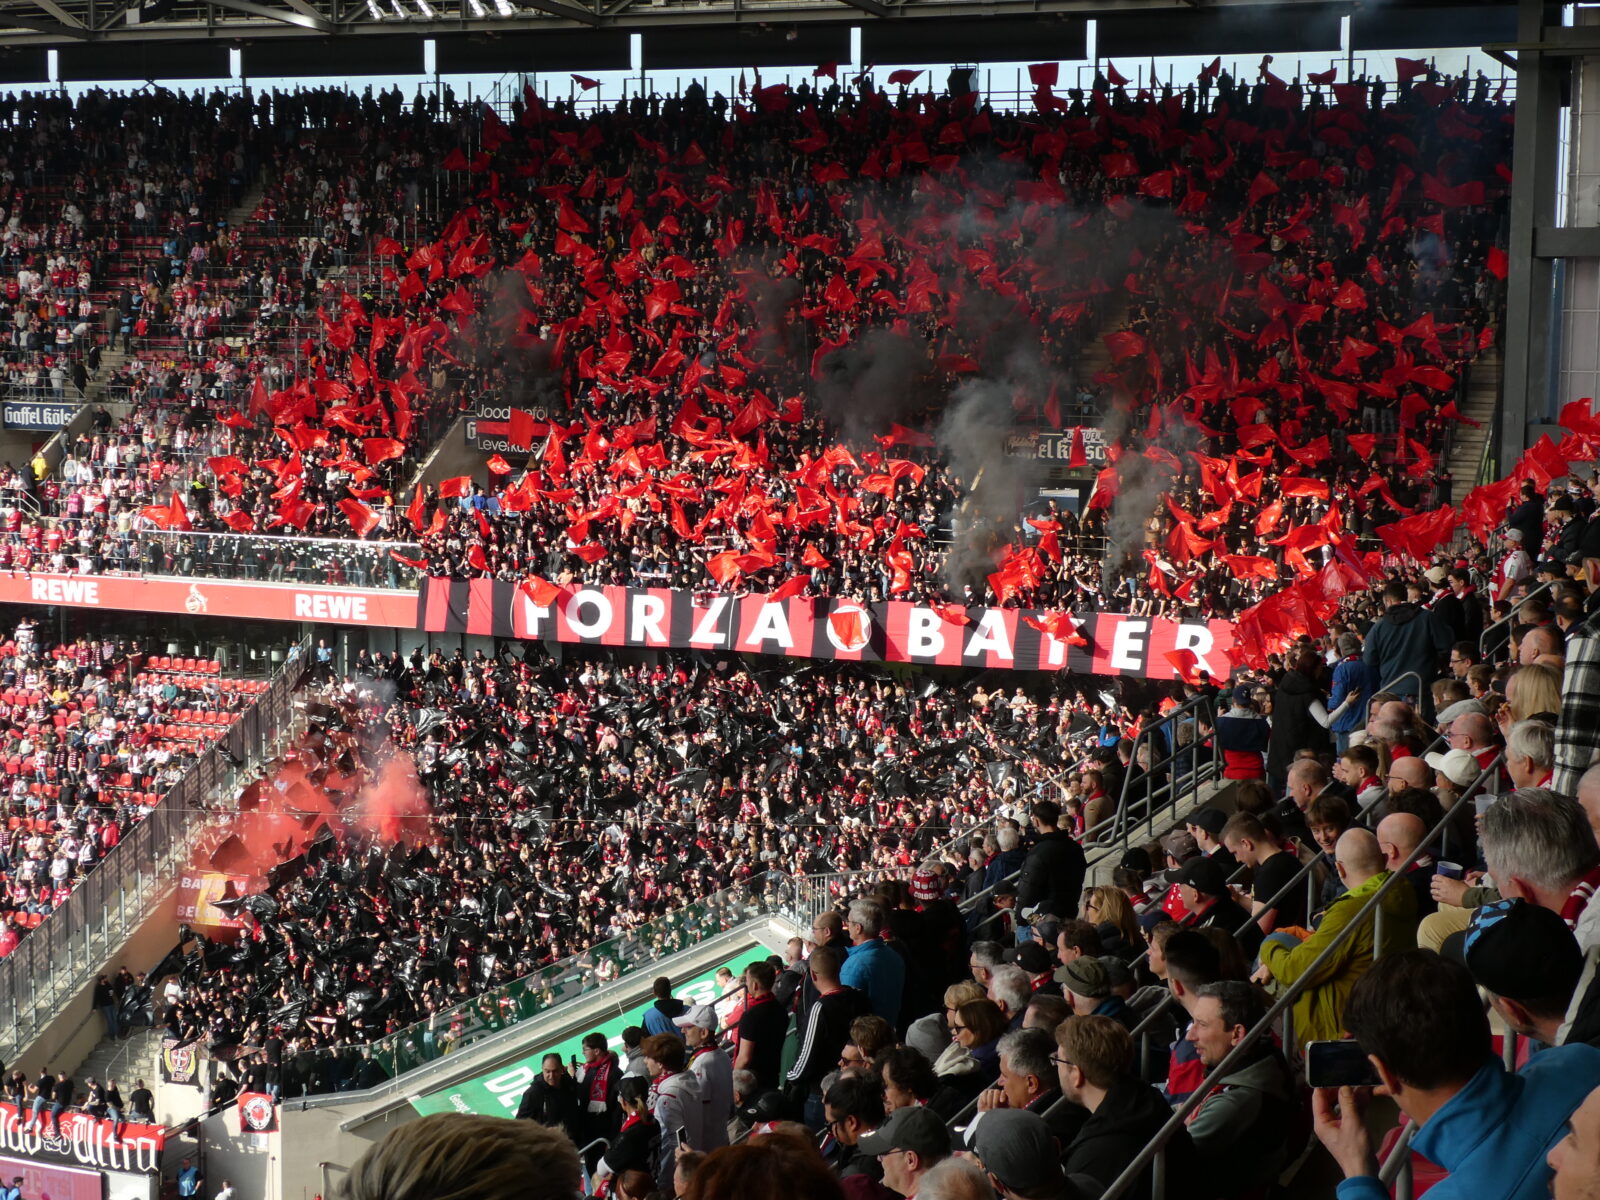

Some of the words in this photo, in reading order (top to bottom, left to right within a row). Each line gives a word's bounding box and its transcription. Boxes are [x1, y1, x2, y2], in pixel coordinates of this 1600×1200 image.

[4, 406, 42, 425] Gaffel
[476, 404, 511, 419] Jood
[31, 578, 99, 604] REWE
[295, 593, 368, 620] REWE
[524, 588, 794, 648] FORZA
[72, 1114, 159, 1173] Ultra
